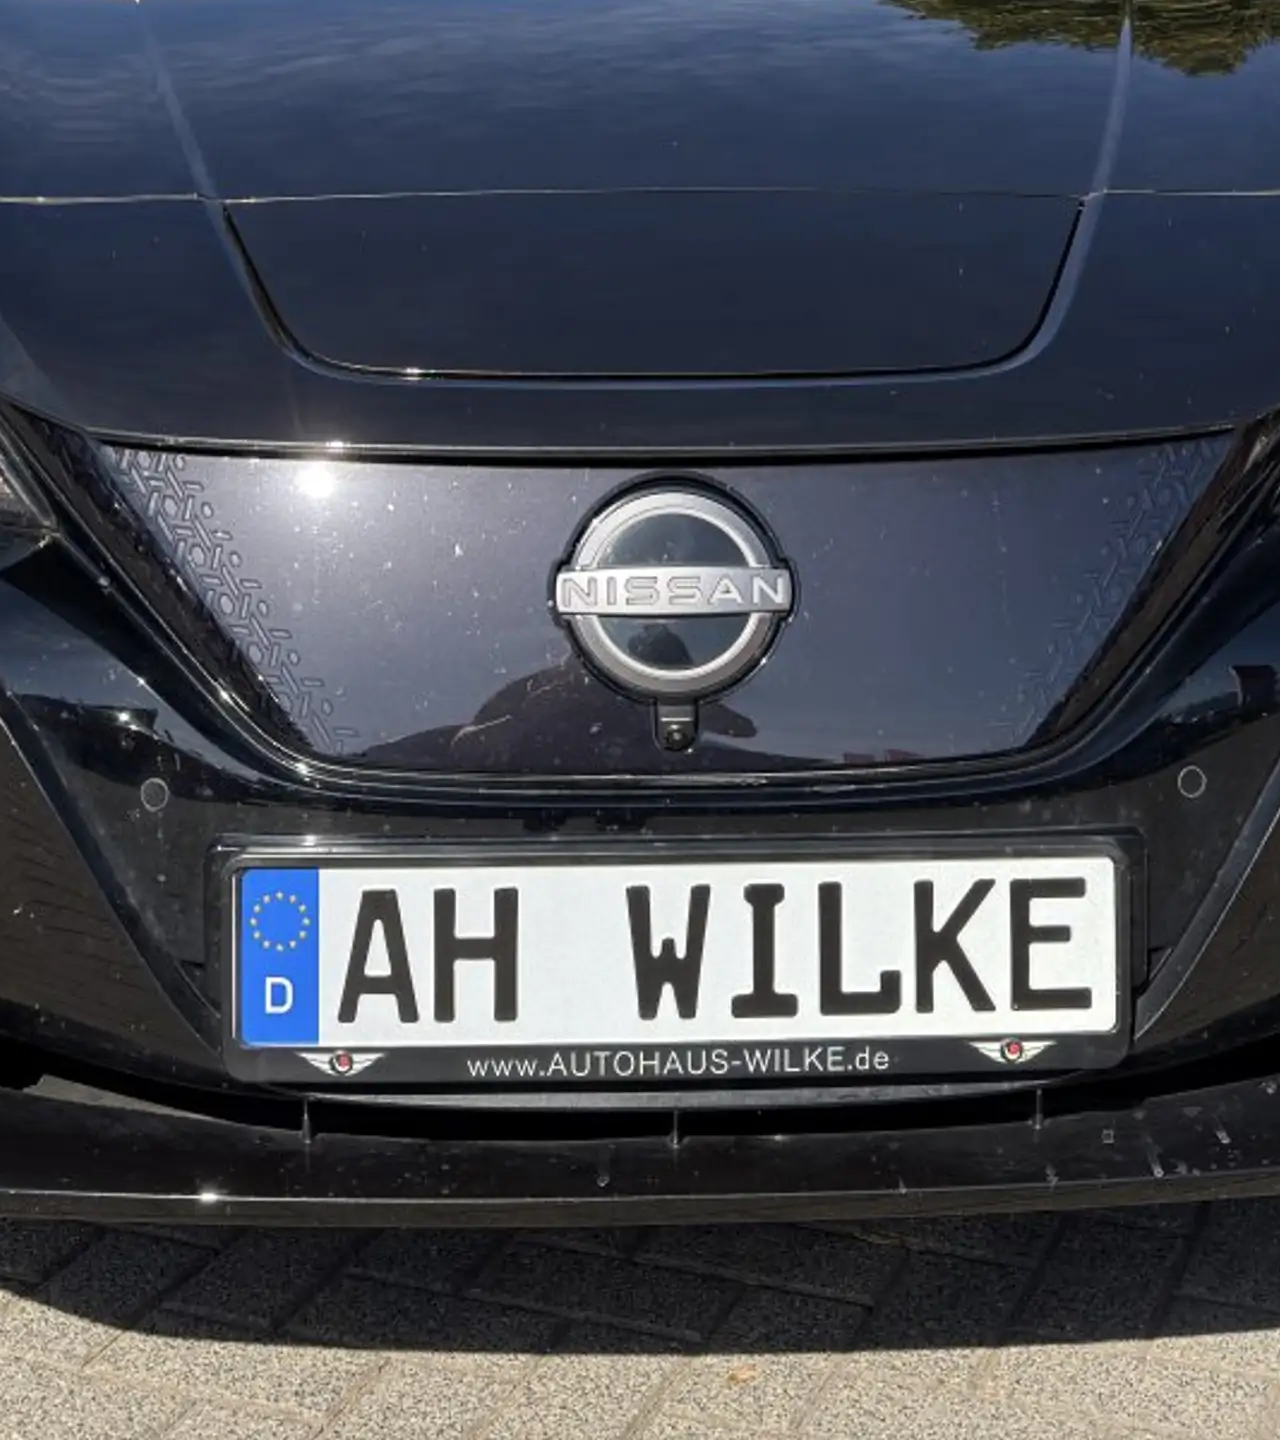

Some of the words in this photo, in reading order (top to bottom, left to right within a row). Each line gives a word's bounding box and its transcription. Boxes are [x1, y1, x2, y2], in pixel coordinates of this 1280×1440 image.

[562, 576, 784, 607] NISSAN
[337, 887, 519, 1023] AH
[625, 877, 1093, 1021] WILKE
[264, 977, 294, 1015] D
[467, 1047, 891, 1078] www.AUTOHAUS-WILKE.de
